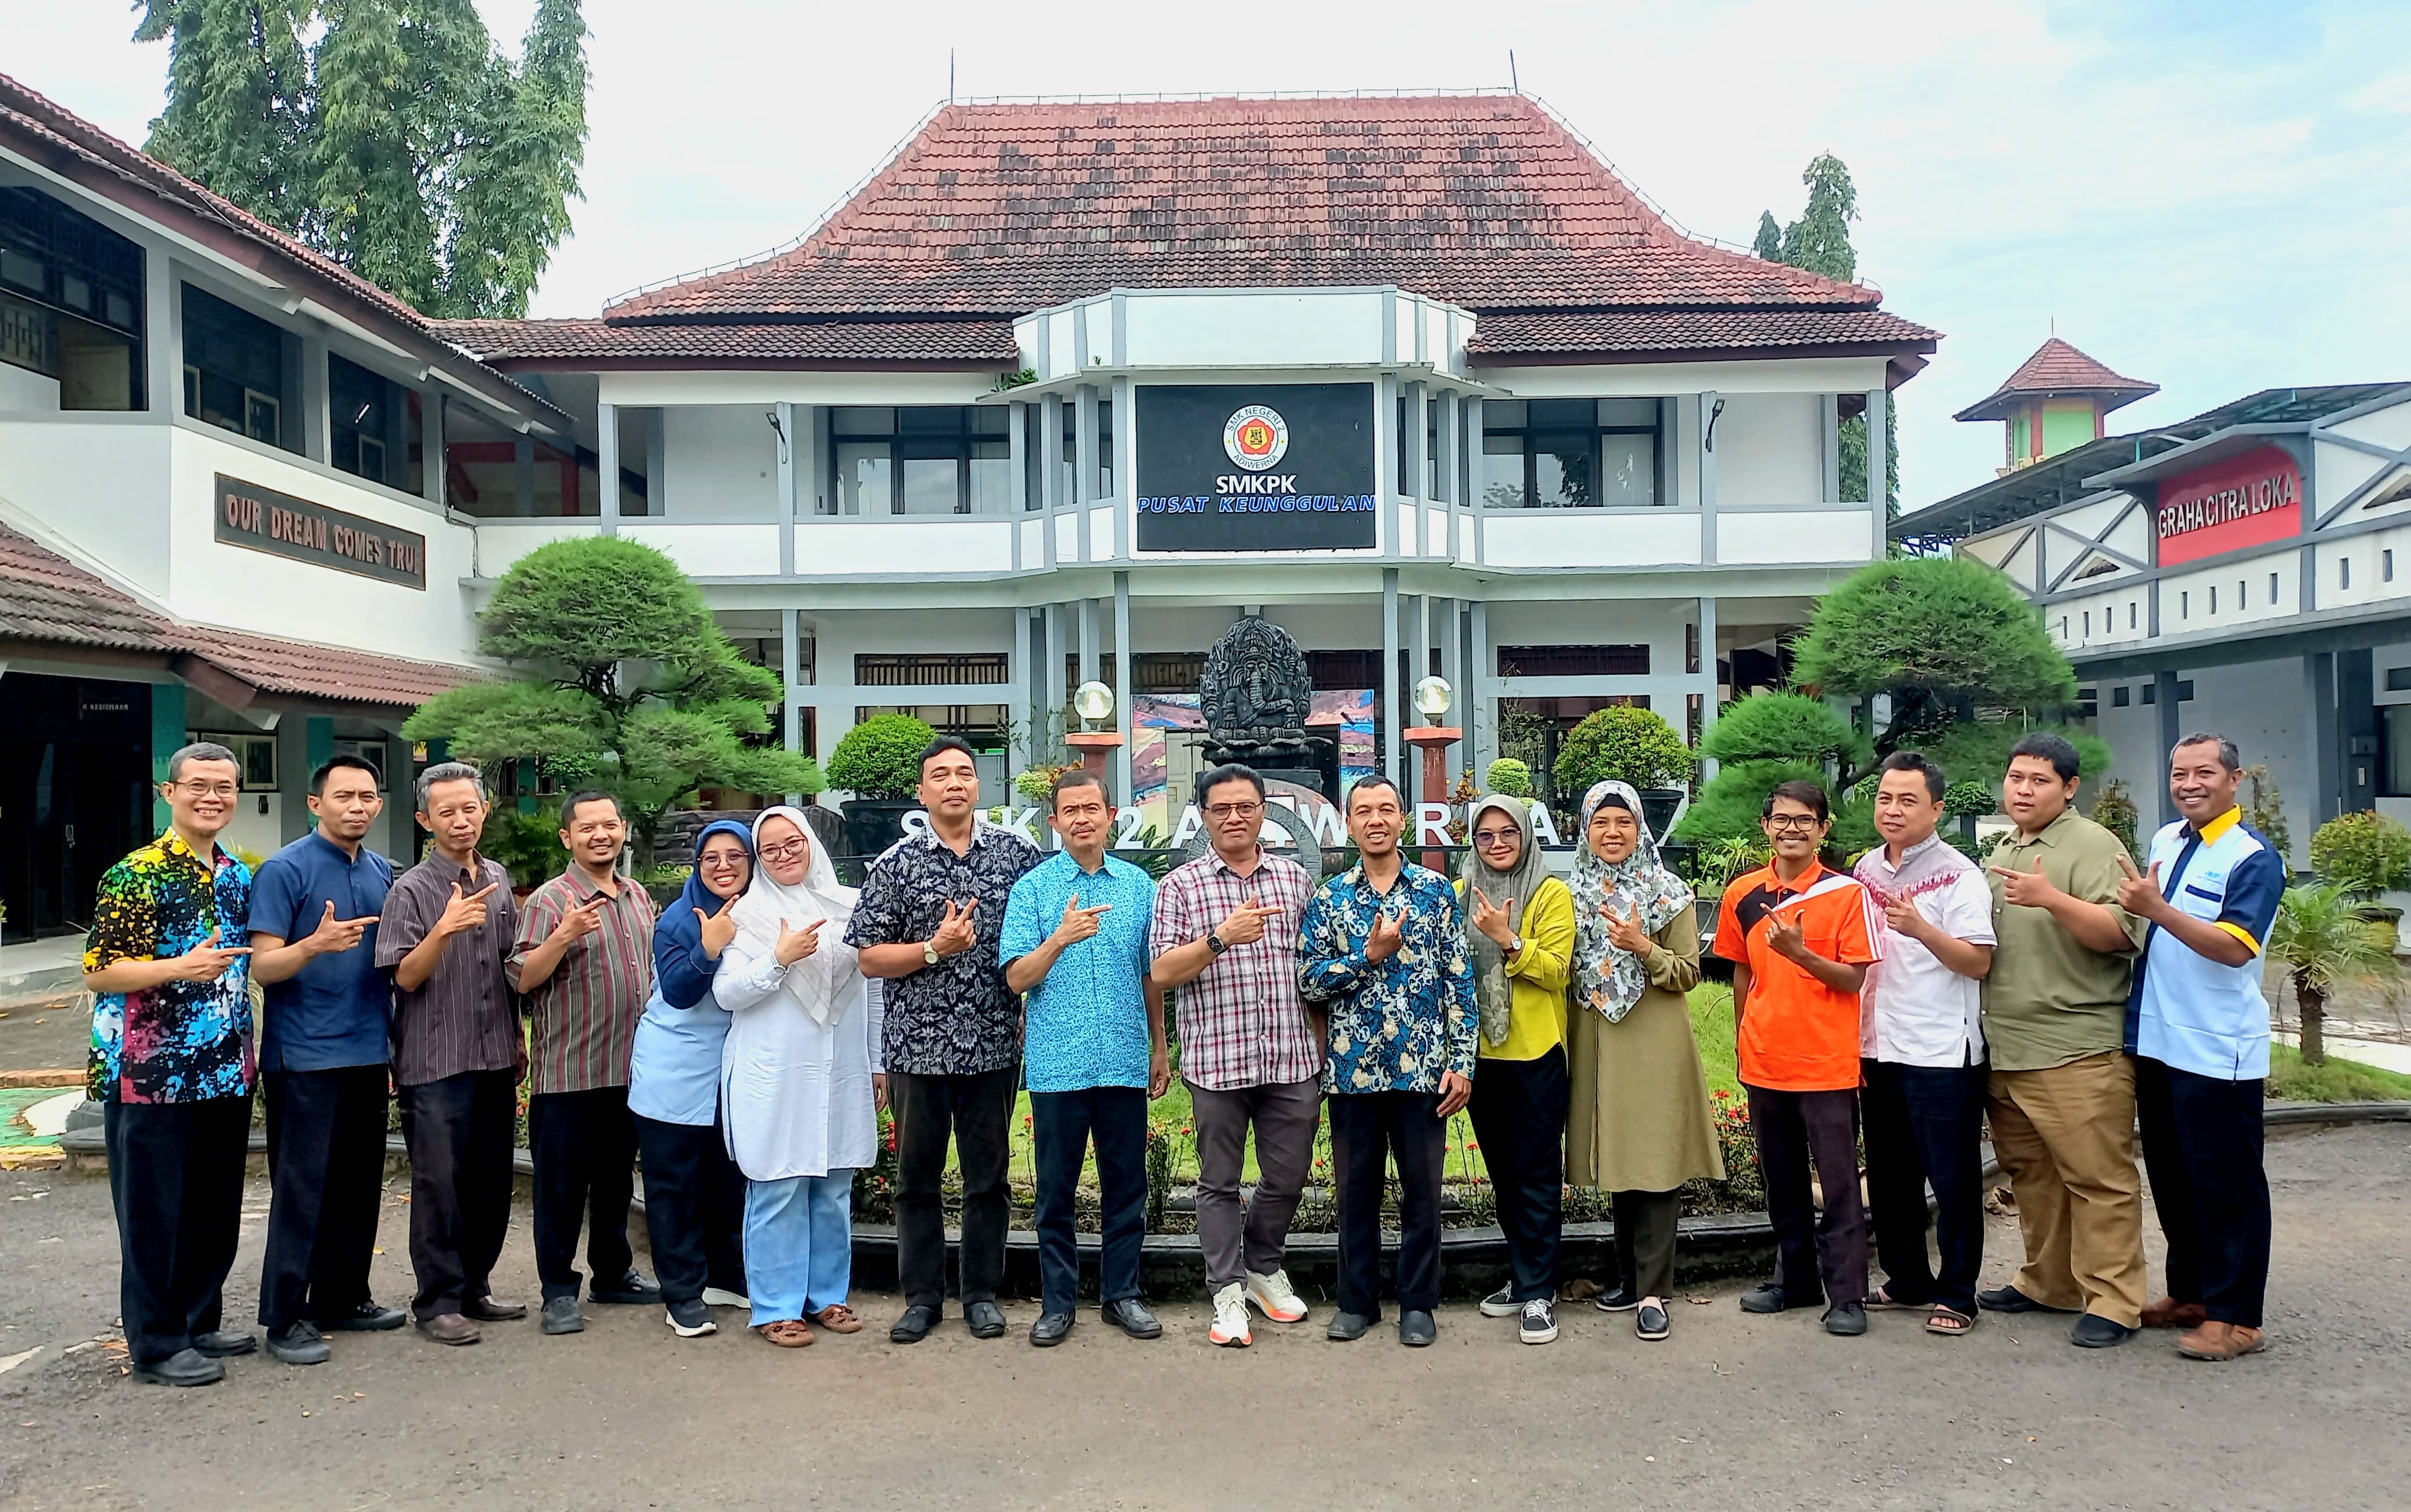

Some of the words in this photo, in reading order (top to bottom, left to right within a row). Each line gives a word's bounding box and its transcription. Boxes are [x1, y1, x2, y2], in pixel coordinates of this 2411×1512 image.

[1227, 412, 1244, 431] SMK
[1245, 407, 1281, 425] NEGERI
[1233, 455, 1278, 469] ADIWERNA
[1216, 474, 1297, 494] SMKPK
[2252, 471, 2295, 514] LOKA
[1138, 496, 1209, 514] PUSAT
[1219, 495, 1375, 513] KEUNGGULAN
[225, 494, 262, 534] OUR
[271, 506, 327, 550] DREAM
[333, 524, 382, 564] COMES
